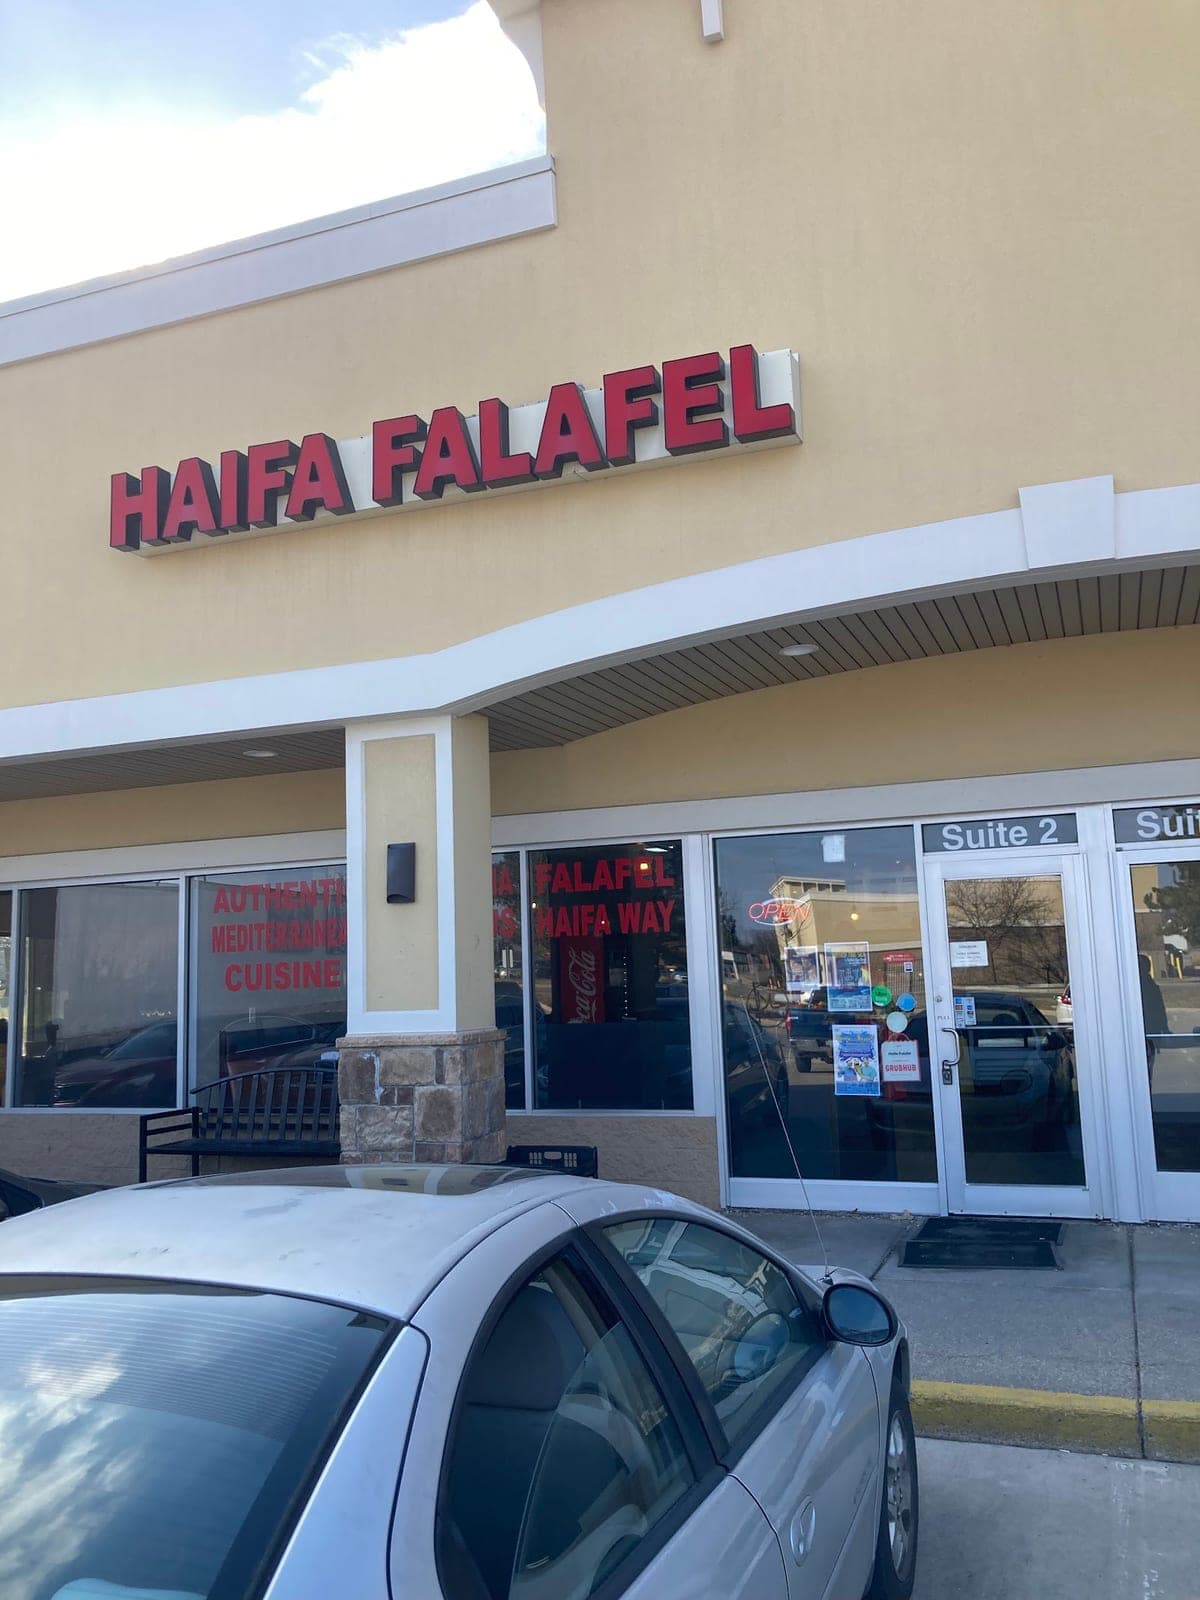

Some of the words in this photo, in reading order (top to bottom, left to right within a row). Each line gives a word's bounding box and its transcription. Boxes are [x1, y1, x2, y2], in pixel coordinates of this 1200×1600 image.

[110, 433, 355, 551] HAIFA
[372, 344, 795, 507] FALAFEL
[942, 822, 1028, 850] Suite
[1038, 817, 1059, 845] 2
[535, 856, 674, 894] FALAFEL
[213, 878, 346, 914] AUTHENTI
[748, 903, 812, 921] OPEN
[212, 918, 346, 953] MEDITERRANEA
[535, 903, 612, 938] HAIFA
[617, 899, 676, 935] WAY
[224, 959, 342, 992] CUISINE
